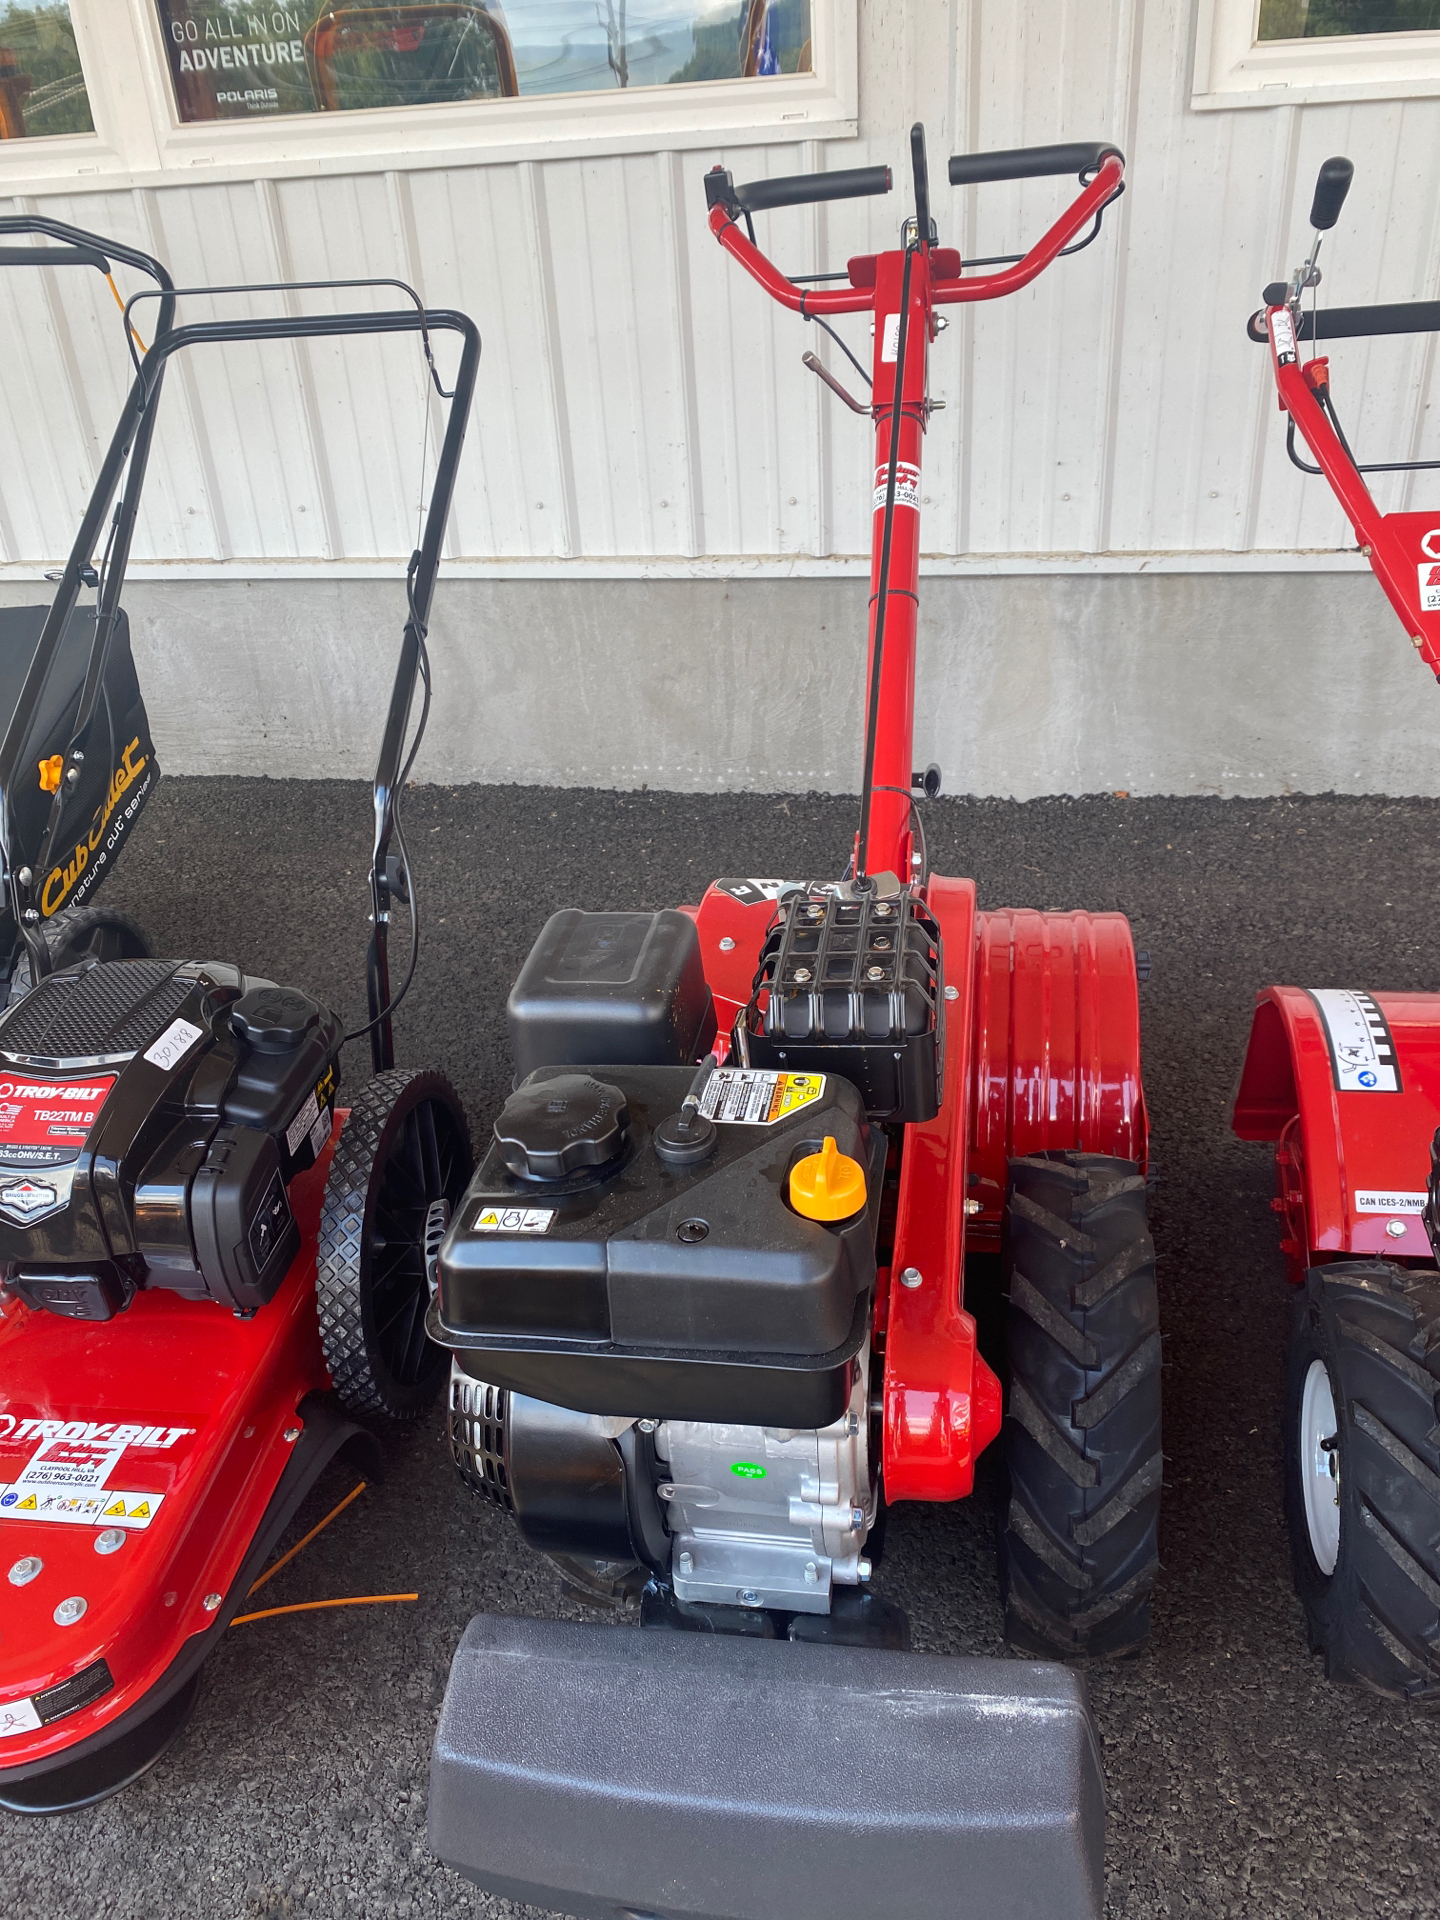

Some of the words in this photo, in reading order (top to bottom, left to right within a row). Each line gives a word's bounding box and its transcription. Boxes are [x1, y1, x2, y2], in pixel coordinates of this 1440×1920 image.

[171, 20, 198, 42] GO
[205, 17, 242, 40] ALL
[247, 13, 268, 36] IN
[272, 10, 300, 33] ON
[180, 39, 305, 72] ADVENTURE
[216, 88, 278, 103] POLARIS
[124, 771, 153, 820] series
[42, 843, 88, 917] Cub
[153, 1028, 193, 1069] 30188
[771, 1086, 783, 1113] WARNING
[33, 1110, 83, 1122] TB22TM
[83, 1112, 94, 1122] B
[1360, 1198, 1377, 1206] CAN
[25, 1470, 52, 1481] (276)
[54, 1471, 100, 1483] 963-0021
[737, 1466, 763, 1475] PASS
